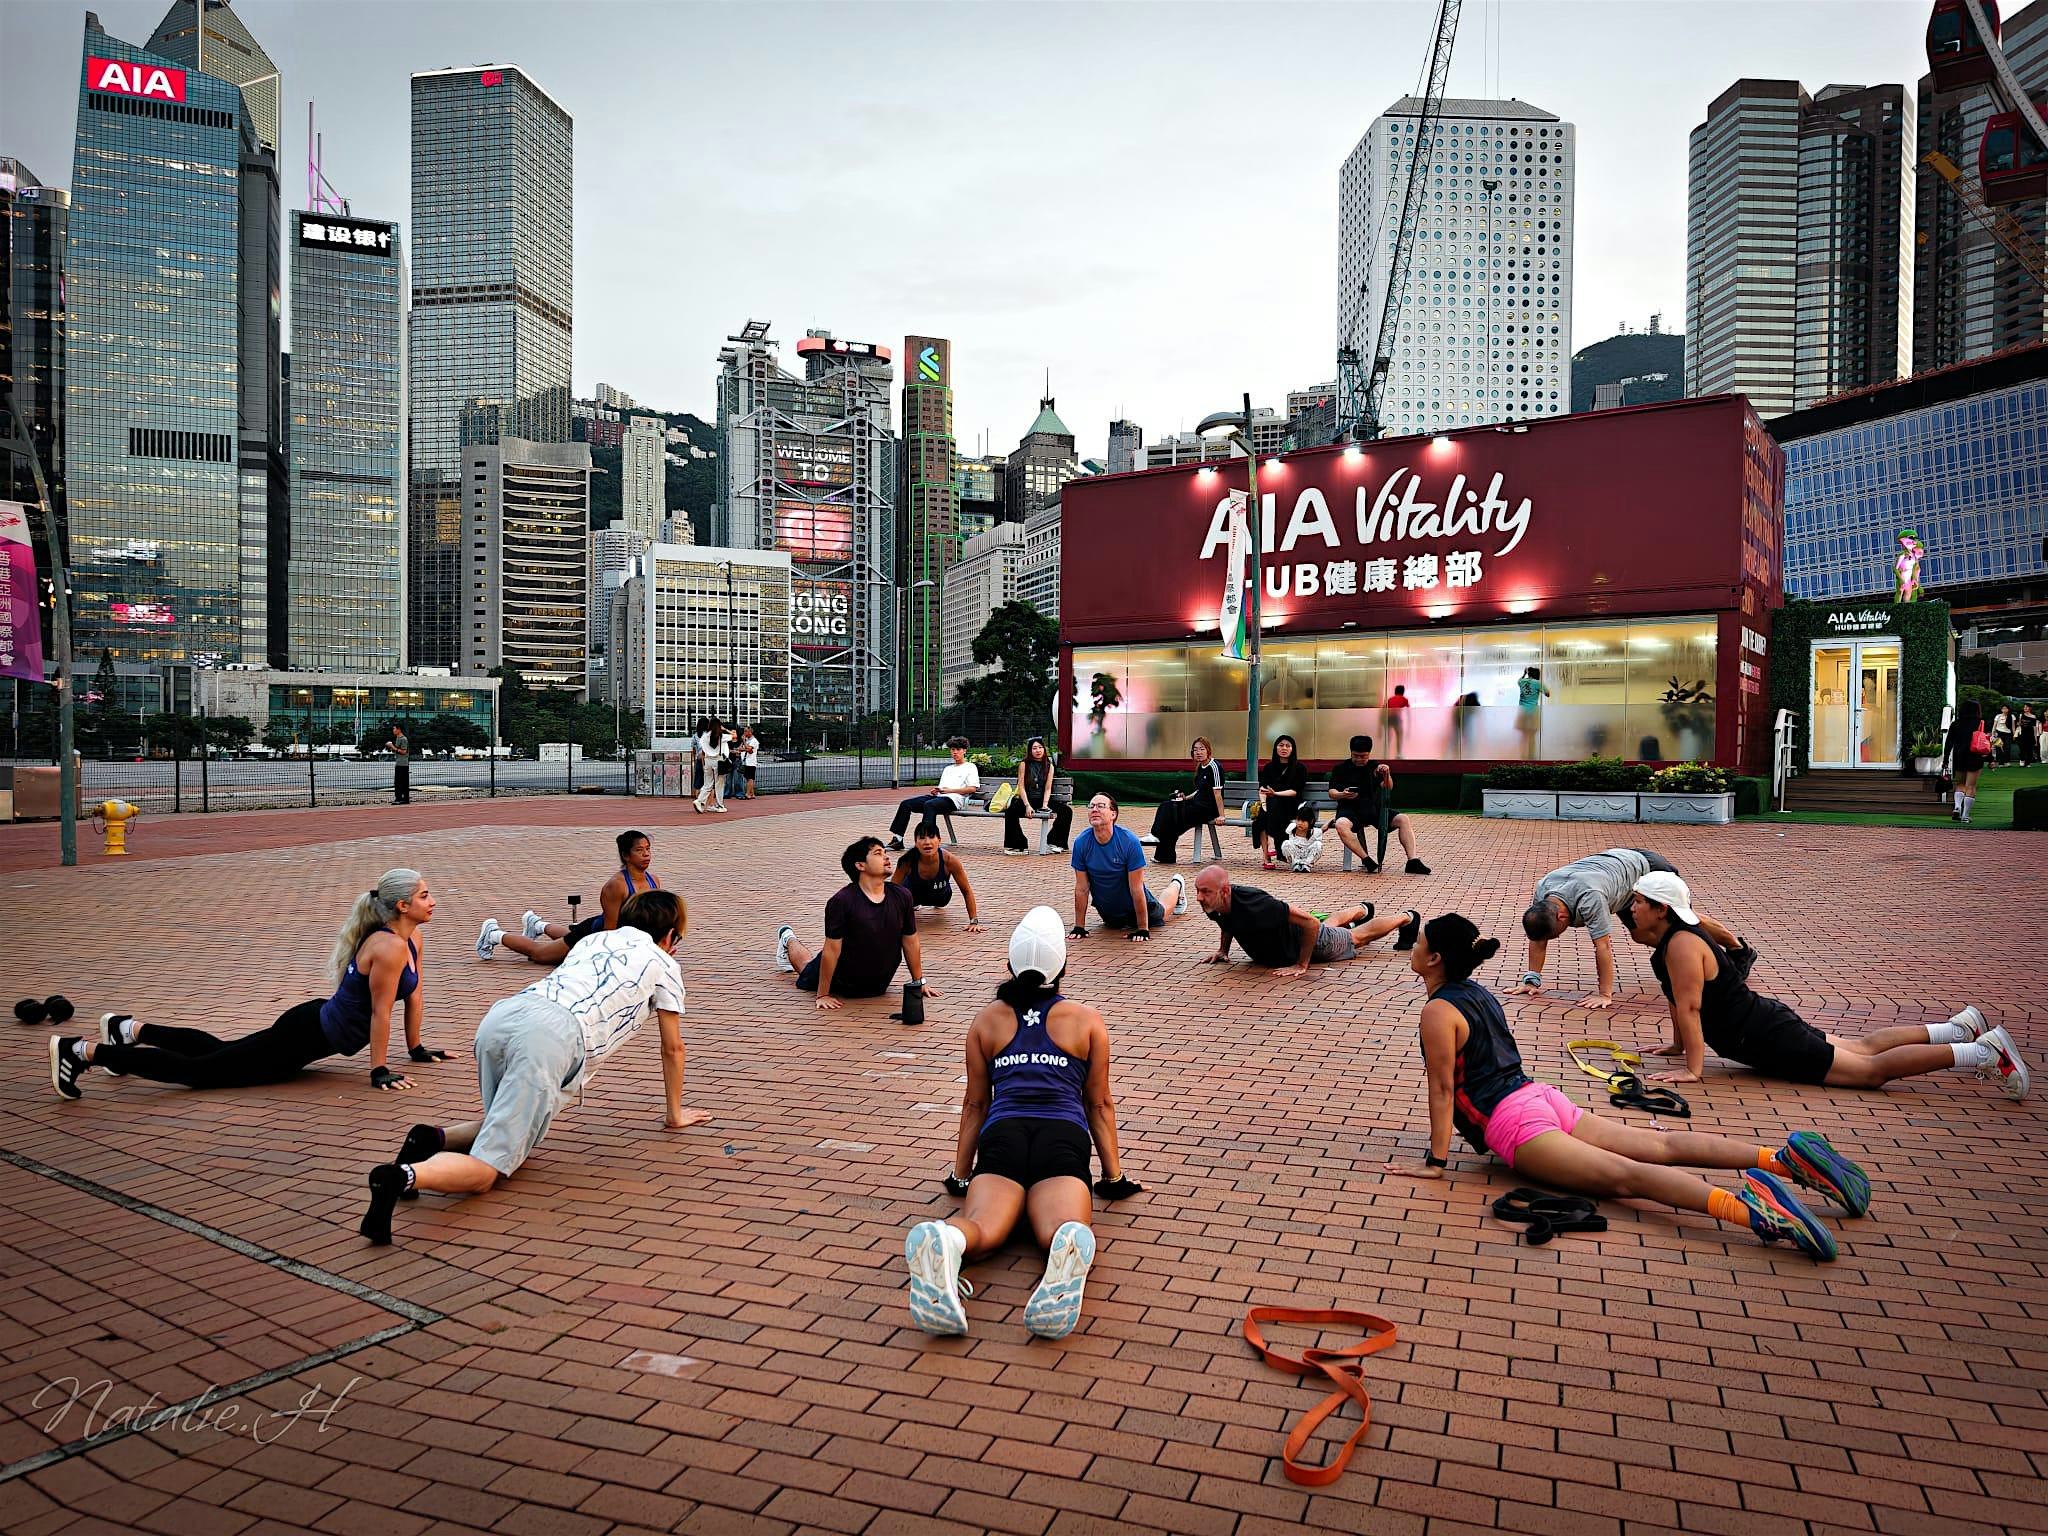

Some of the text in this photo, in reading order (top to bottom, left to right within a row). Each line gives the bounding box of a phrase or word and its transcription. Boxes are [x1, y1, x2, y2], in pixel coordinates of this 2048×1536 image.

[98, 63, 176, 98] AIA
[776, 445, 850, 463] WELCOME
[798, 462, 830, 481] TO
[1200, 467, 1532, 560] AIA Vitality
[1827, 609, 1891, 625] AIA Vitality
[994, 1053, 1068, 1068] HONG KONG
